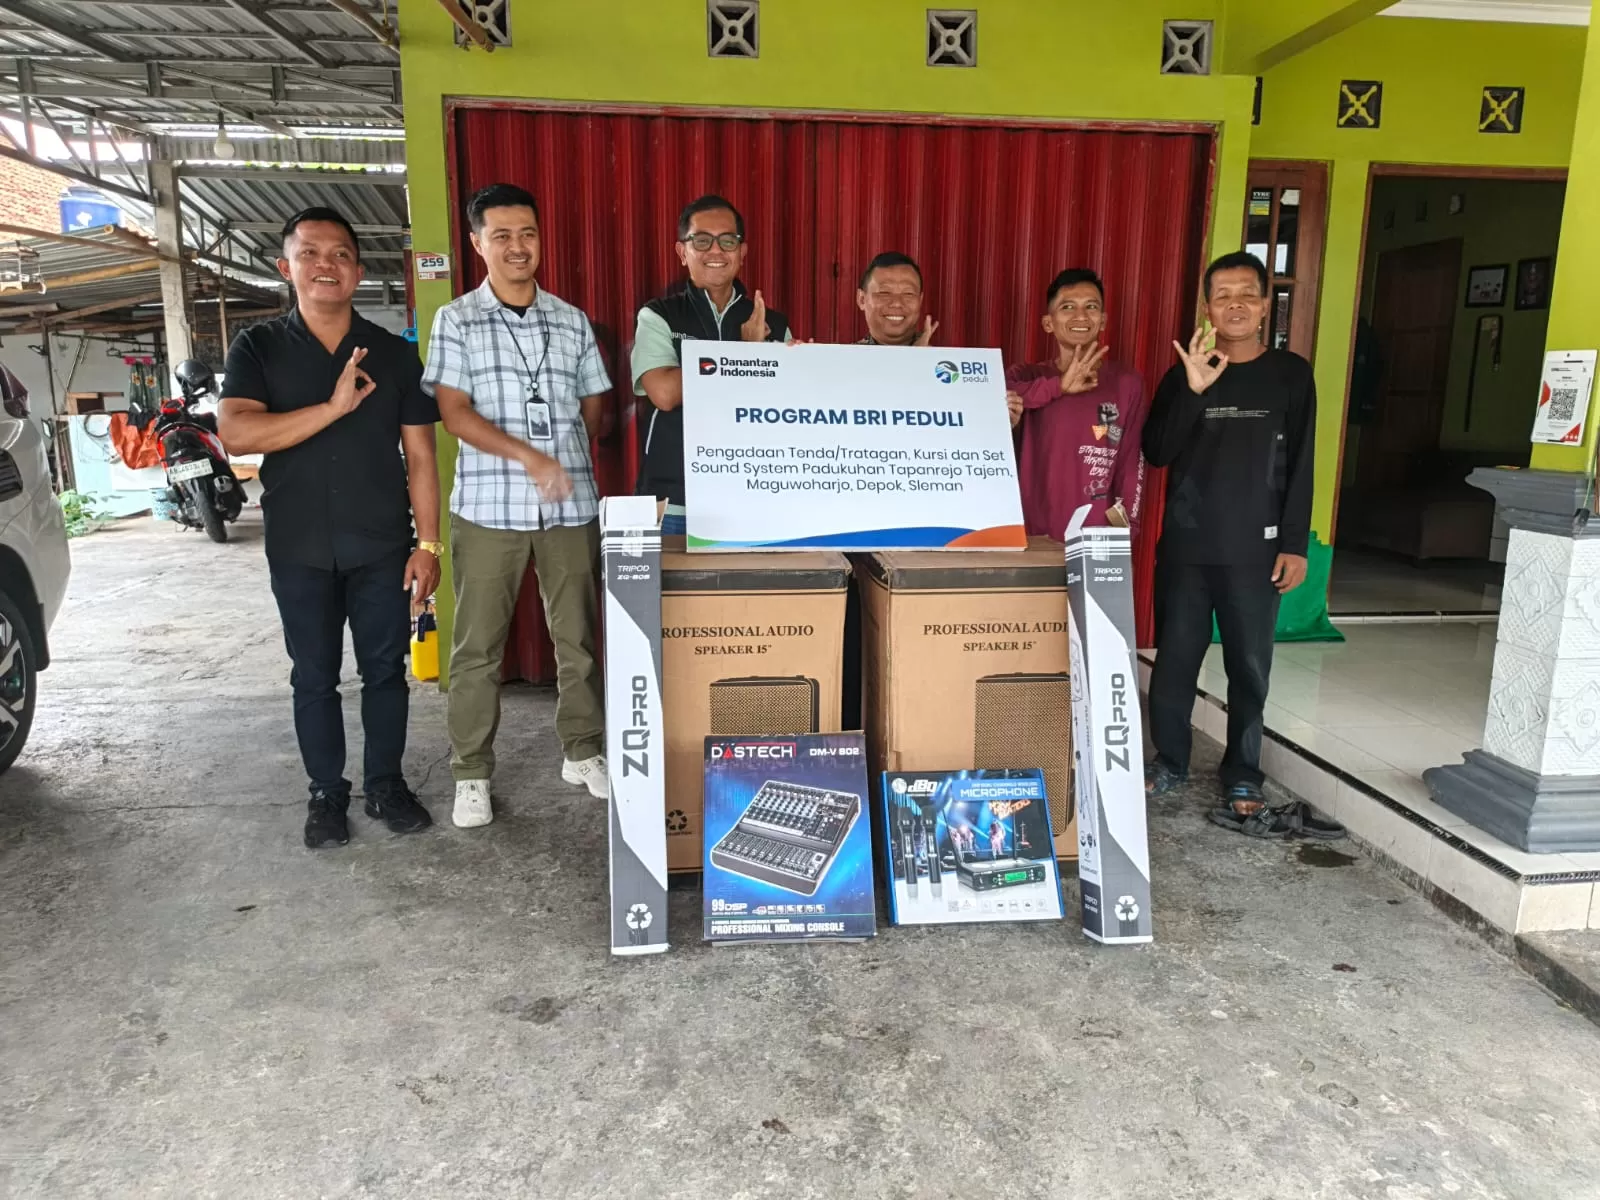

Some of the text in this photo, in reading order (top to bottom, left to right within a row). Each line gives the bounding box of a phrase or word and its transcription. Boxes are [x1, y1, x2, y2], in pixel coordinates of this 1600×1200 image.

[421, 257, 444, 267] 259
[720, 357, 778, 369] Danantara
[961, 361, 987, 375] BRI
[720, 367, 776, 378] Indonesia
[962, 375, 989, 383] peduli
[735, 407, 964, 427] PROGRAM BRI PEDULI
[696, 445, 1005, 462] Pengadaan Tenda/Tratagan, Kursi dan Set
[691, 461, 1013, 479] Sound System Padukuhan Tapanrejo Tajem,
[746, 477, 964, 494] Maguwoharjo, Depok, Sleman
[617, 565, 650, 573] TRIPOD
[661, 625, 814, 639] ROFESSIONAL AUDIO
[923, 621, 1068, 636] PROFESSIONAL AUDI
[694, 644, 772, 656] SPEAKER 15"
[963, 640, 1036, 652] SPEAKER 15"
[711, 746, 860, 759] DASTECH DM-V 802
[960, 787, 1039, 798] MICROPHONE
[711, 922, 845, 935] PROFESSIONAL MIXING CONSOLE
